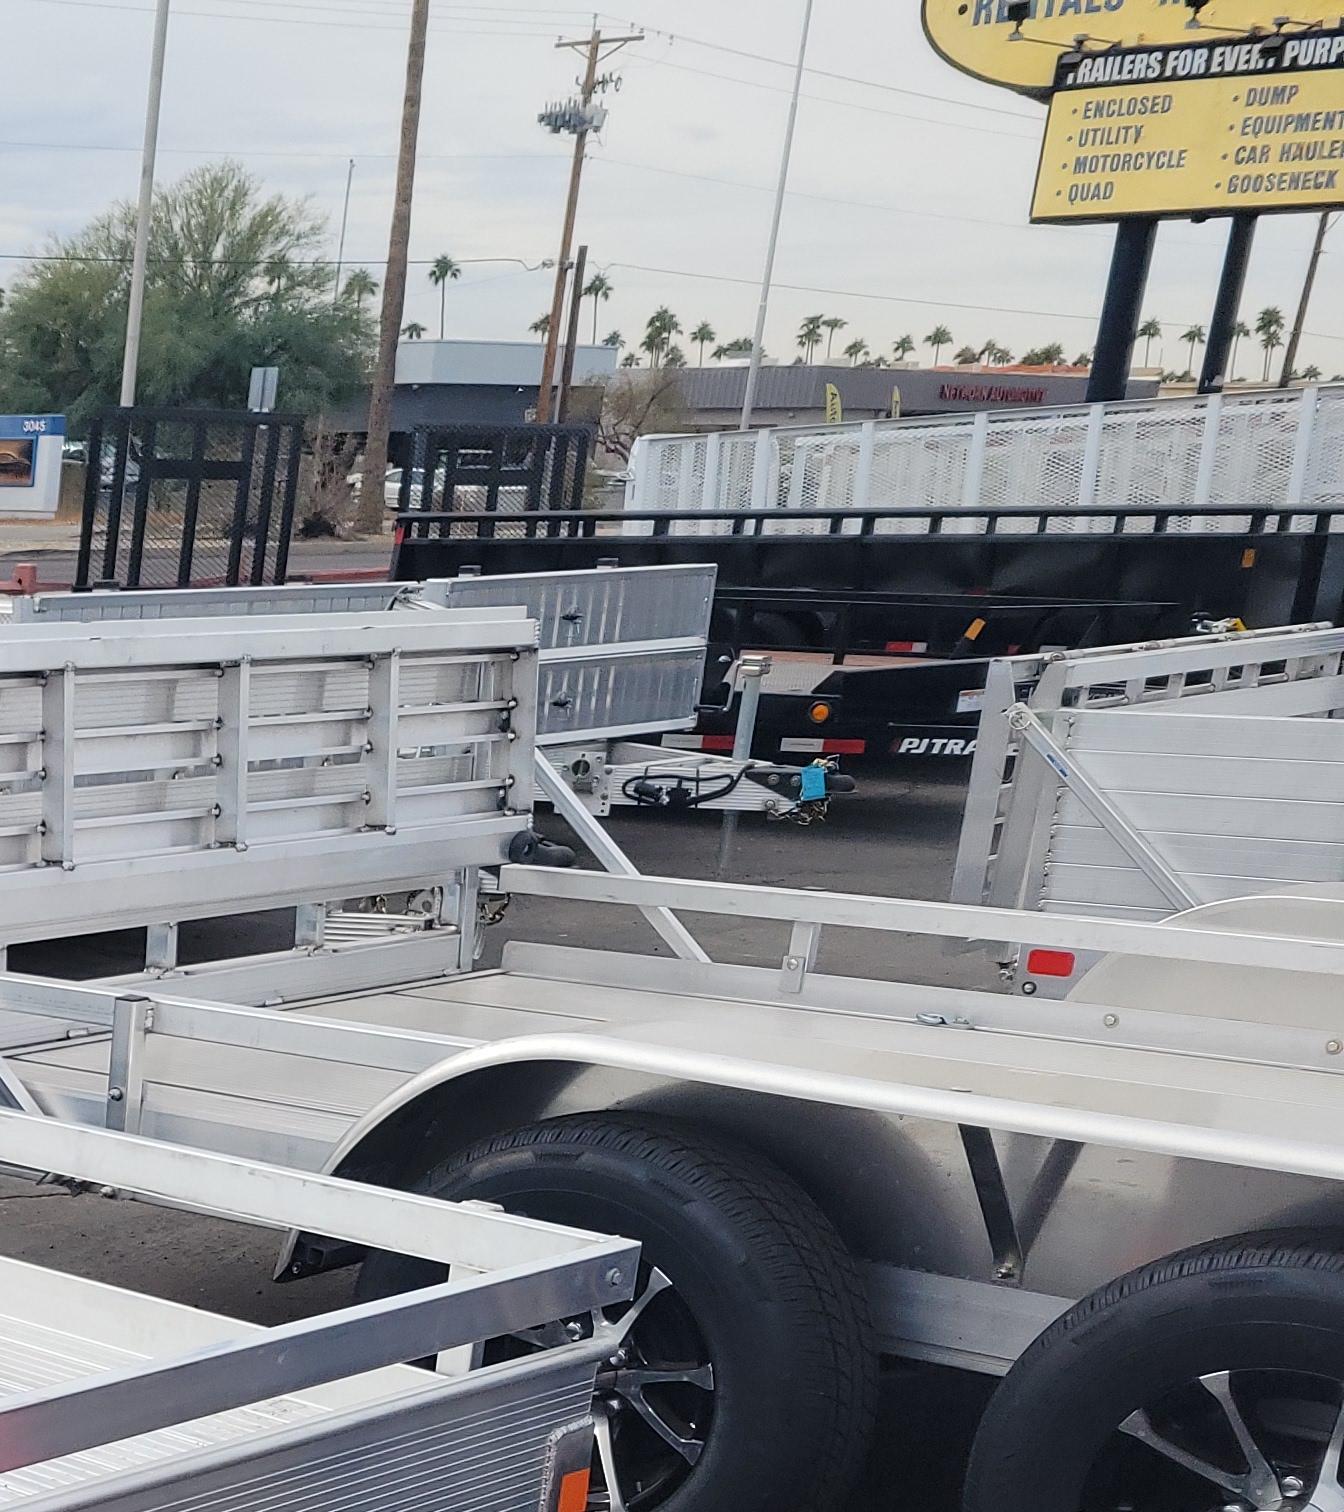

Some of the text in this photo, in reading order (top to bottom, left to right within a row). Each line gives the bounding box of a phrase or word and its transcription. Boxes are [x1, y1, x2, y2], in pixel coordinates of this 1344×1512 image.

[1066, 51, 1162, 84] RAILERS
[1164, 47, 1208, 77] FOR
[1082, 94, 1173, 120] ENCLOSED
[1244, 84, 1299, 107] DUMP
[1078, 124, 1144, 148] UTILITY
[1073, 149, 1188, 175] MOTORCYCLE
[1234, 143, 1271, 165] CAR
[1068, 181, 1114, 205] QUAD
[1227, 169, 1339, 194] GOOSENECK
[22, 419, 46, 432] 3045
